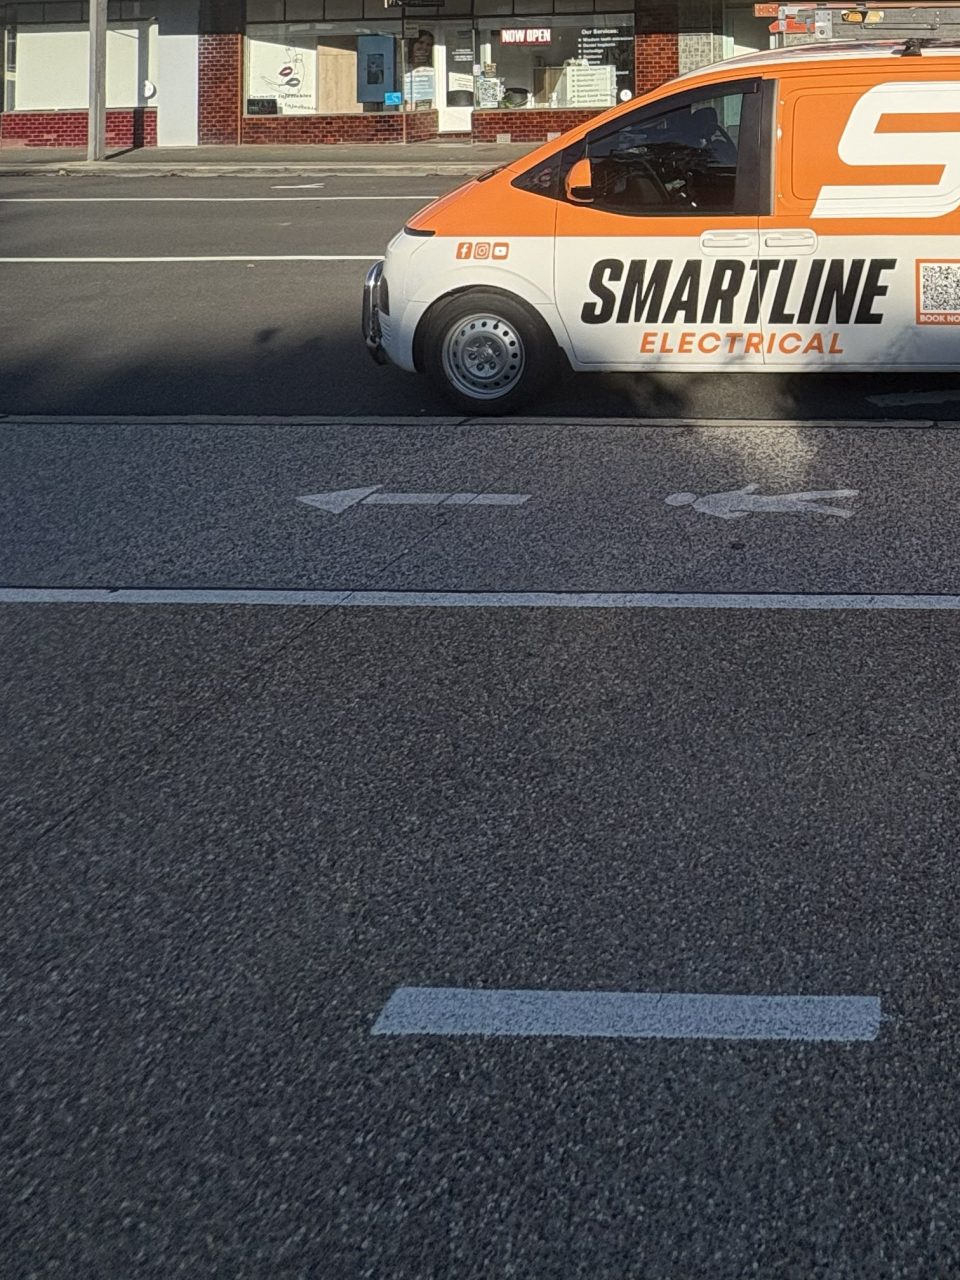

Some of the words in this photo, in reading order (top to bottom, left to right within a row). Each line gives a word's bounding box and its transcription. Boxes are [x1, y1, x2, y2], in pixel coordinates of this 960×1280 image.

[502, 29, 525, 43] NOW
[526, 28, 551, 42] OPEN
[581, 258, 898, 325] SMARTLINE
[920, 314, 946, 322] BOOK
[639, 332, 844, 355] ELECTRICAL
